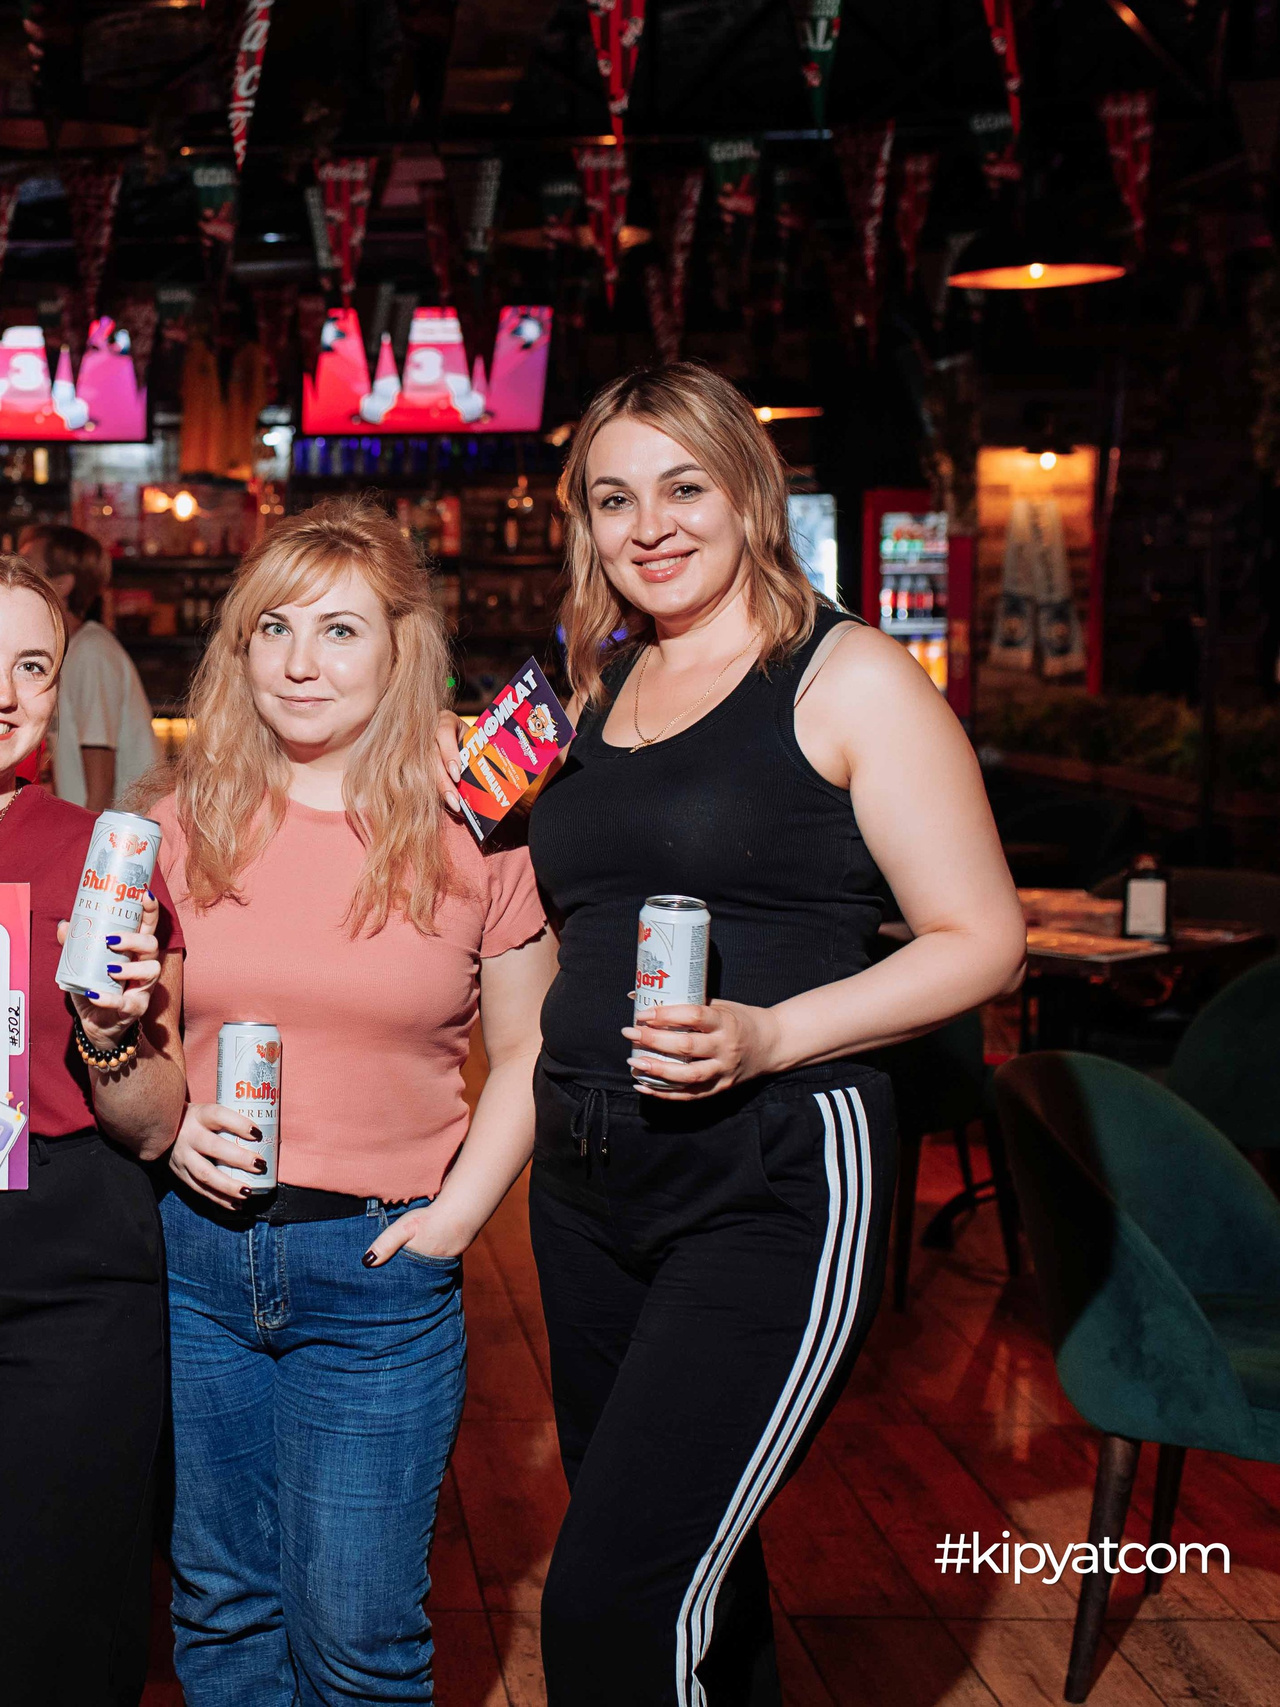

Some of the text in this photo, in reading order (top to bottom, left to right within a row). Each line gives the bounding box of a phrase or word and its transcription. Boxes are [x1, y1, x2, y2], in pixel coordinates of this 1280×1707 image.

[9, 352, 45, 391] 3
[409, 347, 443, 385] 3
[460, 669, 538, 775] РТИФИКАТ
[477, 756, 510, 807] ПИЦЦУ
[8, 1006, 20, 1046] #502
